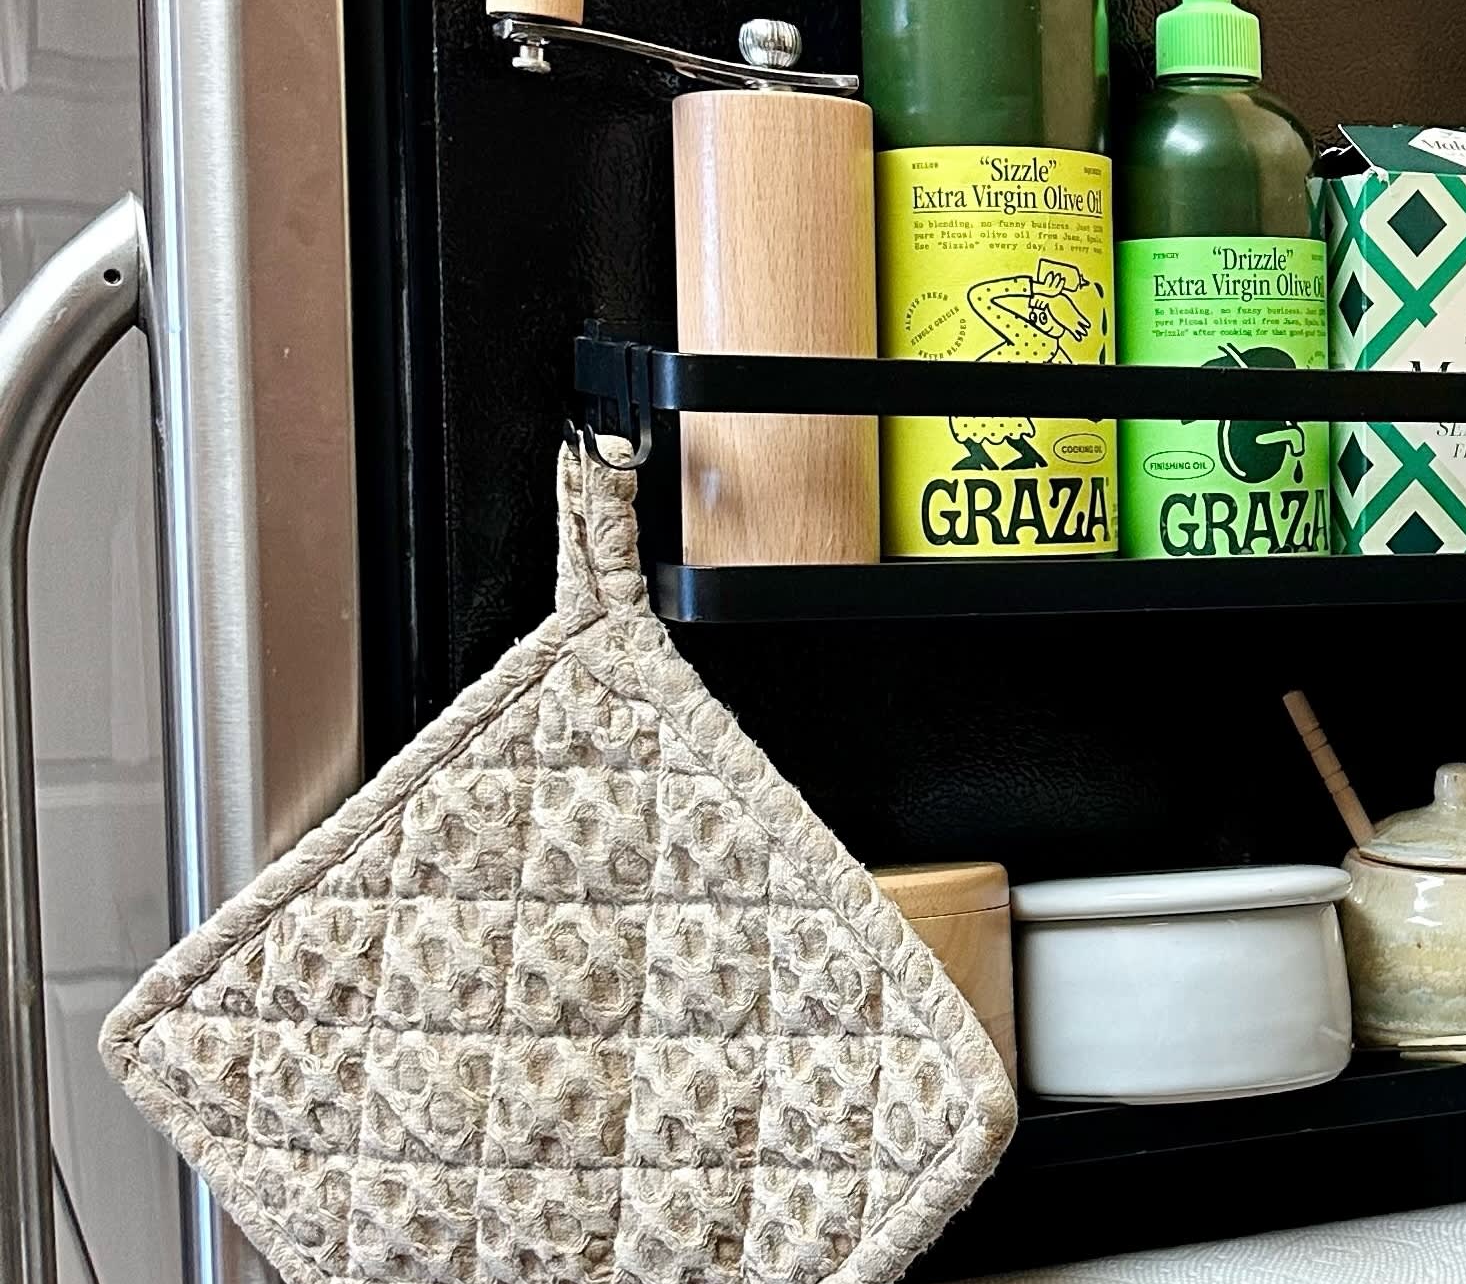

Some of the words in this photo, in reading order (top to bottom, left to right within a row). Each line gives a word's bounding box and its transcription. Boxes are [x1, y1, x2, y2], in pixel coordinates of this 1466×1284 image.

[911, 185, 968, 210] Extra
[971, 184, 1038, 216] Virgin
[1043, 185, 1084, 213] Olive
[1086, 189, 1104, 215] Oil
[1153, 274, 1208, 298] Extra
[1211, 273, 1271, 303] Virgin
[1276, 272, 1312, 298] Olive
[1061, 445, 1094, 455] COOKING
[1149, 461, 1191, 471] FINISHING
[1192, 461, 1208, 471] OIL
[921, 476, 1110, 546] GRAZA
[1159, 489, 1330, 557] GRAZA
